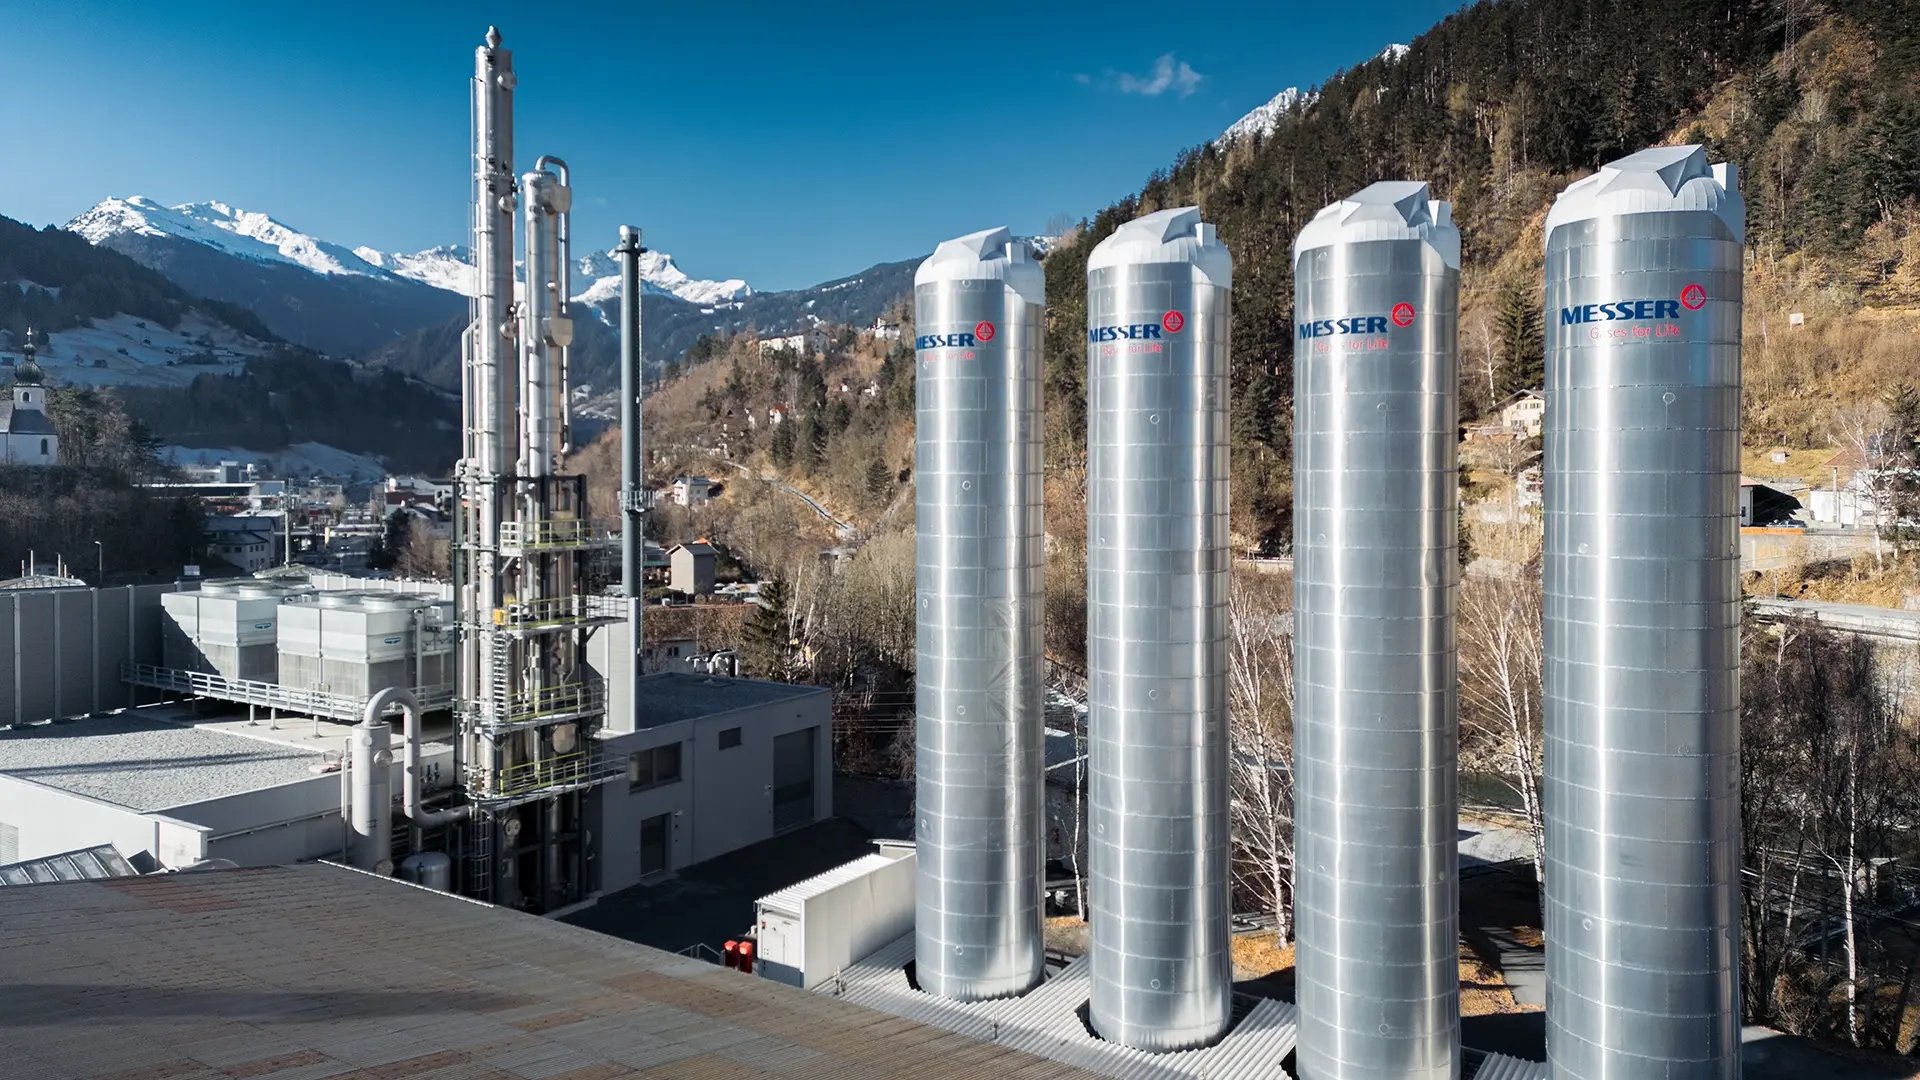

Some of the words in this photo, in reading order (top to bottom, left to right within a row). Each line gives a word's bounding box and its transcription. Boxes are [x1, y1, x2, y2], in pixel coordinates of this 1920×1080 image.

[1562, 300, 1680, 326] MESSER
[1089, 323, 1162, 343] MESSER
[1299, 316, 1389, 340] MESSER
[1589, 326, 1628, 339] Gses
[1631, 324, 1652, 337] for
[1655, 322, 1680, 337] Life
